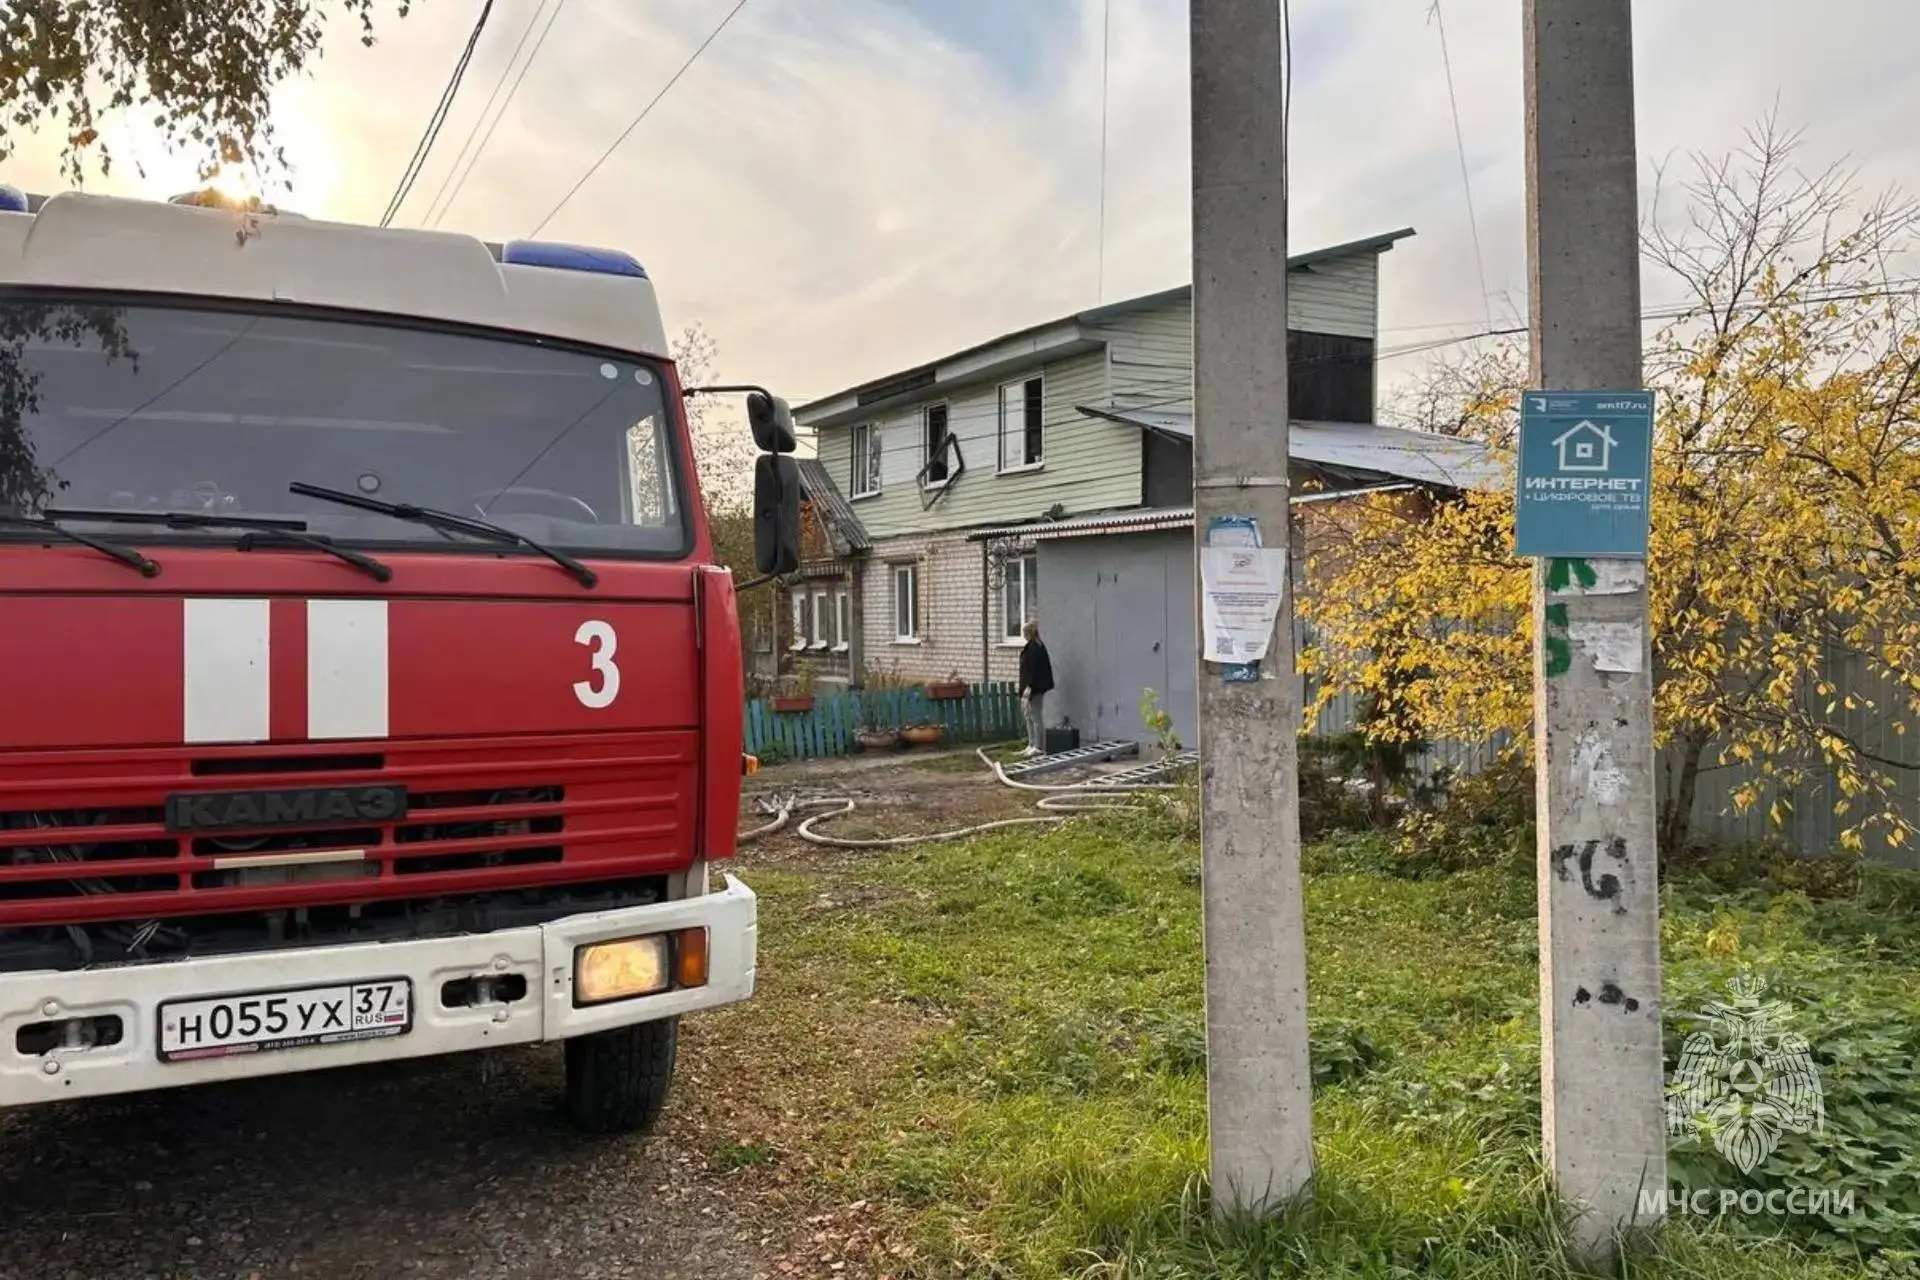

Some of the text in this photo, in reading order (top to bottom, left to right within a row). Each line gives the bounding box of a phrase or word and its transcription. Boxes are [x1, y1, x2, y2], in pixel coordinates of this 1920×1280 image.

[1525, 477, 1642, 491] ИНТЕРНЕТ
[1621, 492, 1641, 503] ТВ
[573, 619, 620, 708] 3
[176, 787, 398, 828] КАМАЗ
[356, 985, 394, 1014] 37
[355, 1013, 383, 1025] RUS
